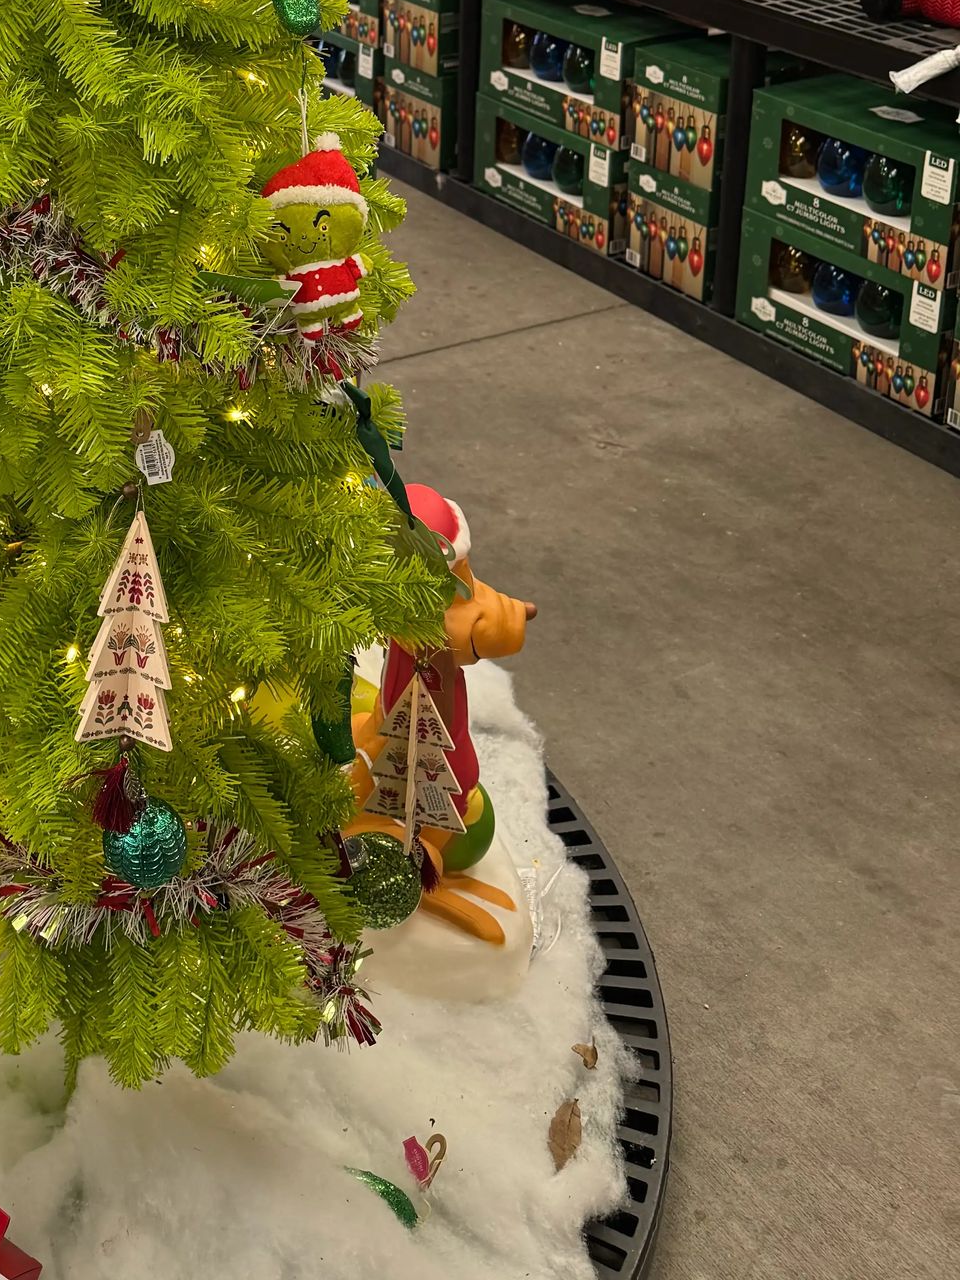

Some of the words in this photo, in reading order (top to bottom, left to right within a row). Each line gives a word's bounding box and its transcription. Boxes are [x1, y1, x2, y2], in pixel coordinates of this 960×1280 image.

[931, 156, 947, 169] LED
[794, 200, 838, 223] MULTICOLOR
[812, 197, 820, 208] 8
[795, 207, 818, 222] JUMBO
[820, 217, 845, 234] LIGHTS
[919, 286, 935, 299] LED
[783, 318, 828, 344] MULTICOLOR
[802, 317, 809, 327] 8
[784, 324, 807, 341] JUMBO
[808, 337, 835, 355] LIGHTS
